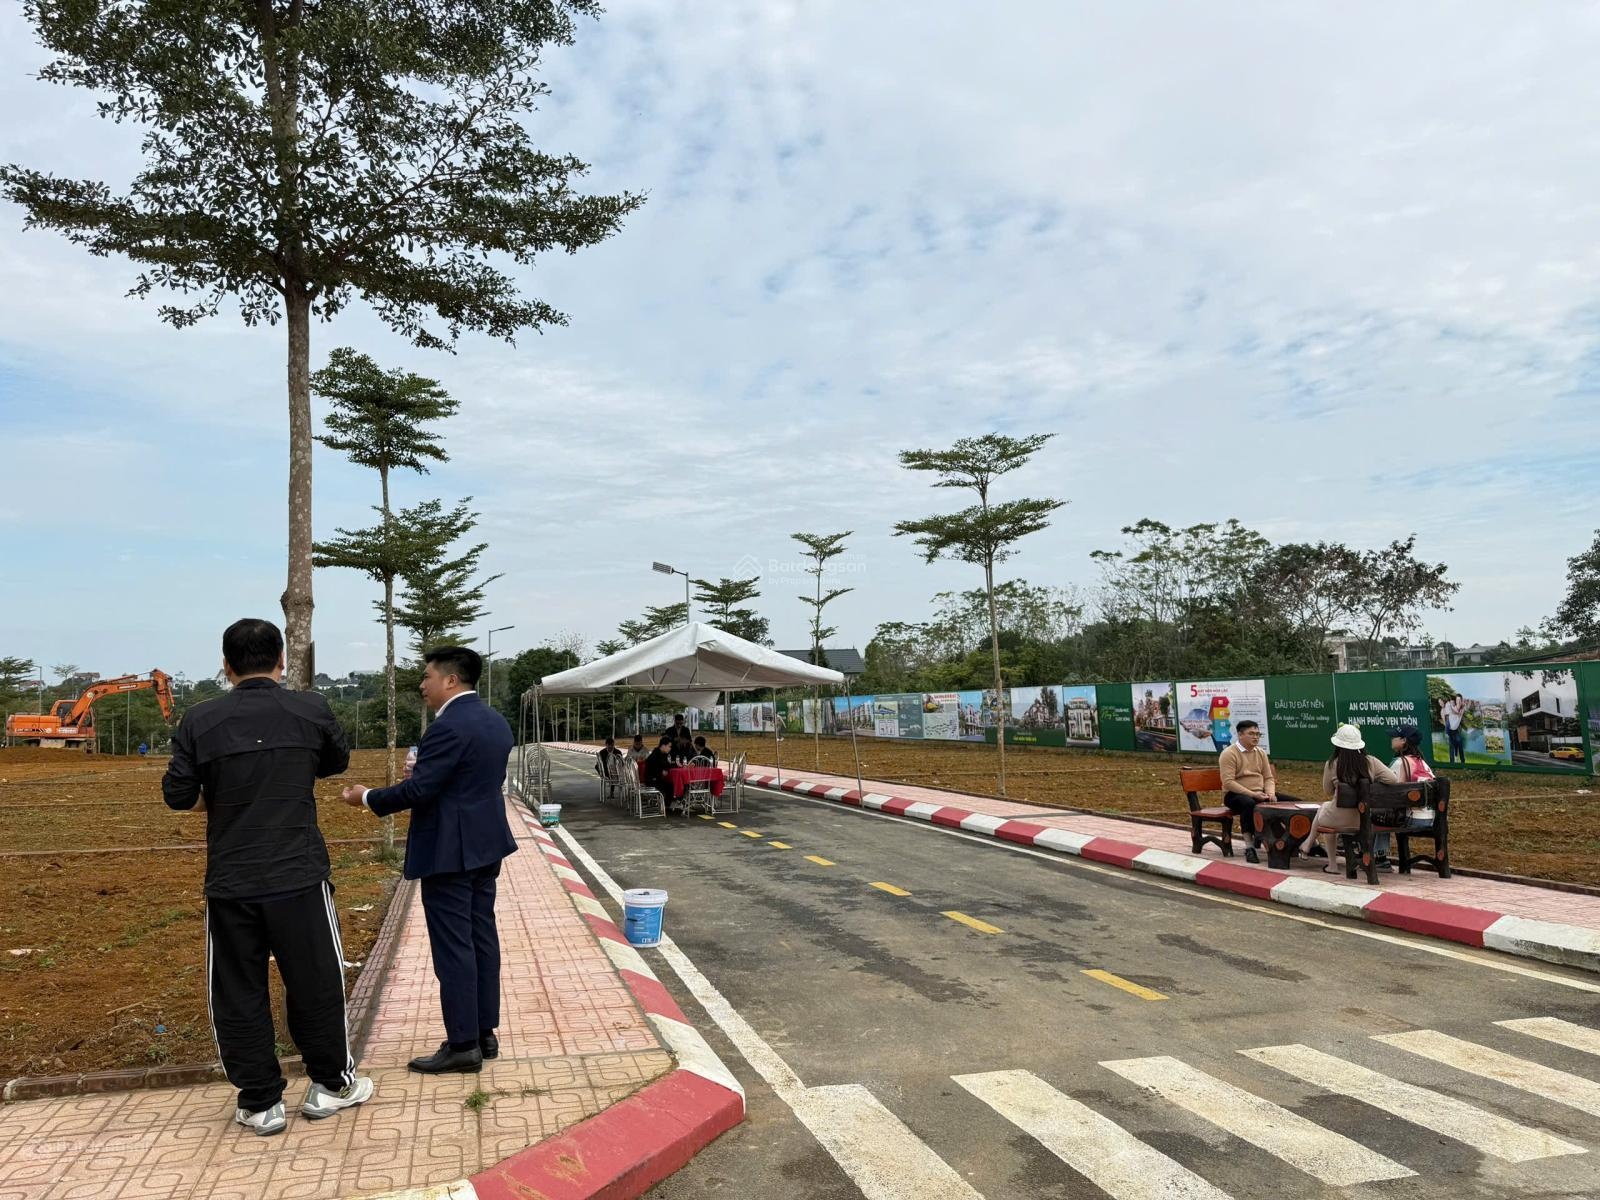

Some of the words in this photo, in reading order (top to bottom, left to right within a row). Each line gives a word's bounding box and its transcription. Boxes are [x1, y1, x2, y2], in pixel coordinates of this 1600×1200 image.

[1190, 684, 1198, 697] 5
[1349, 702, 1358, 711] AN
[1359, 701, 1369, 711] CƯ
[1369, 701, 1389, 713] THỊNH
[1389, 701, 1415, 713] VƯỢNG
[1366, 714, 1385, 726] PHÚC
[1385, 716, 1399, 728] VẸN
